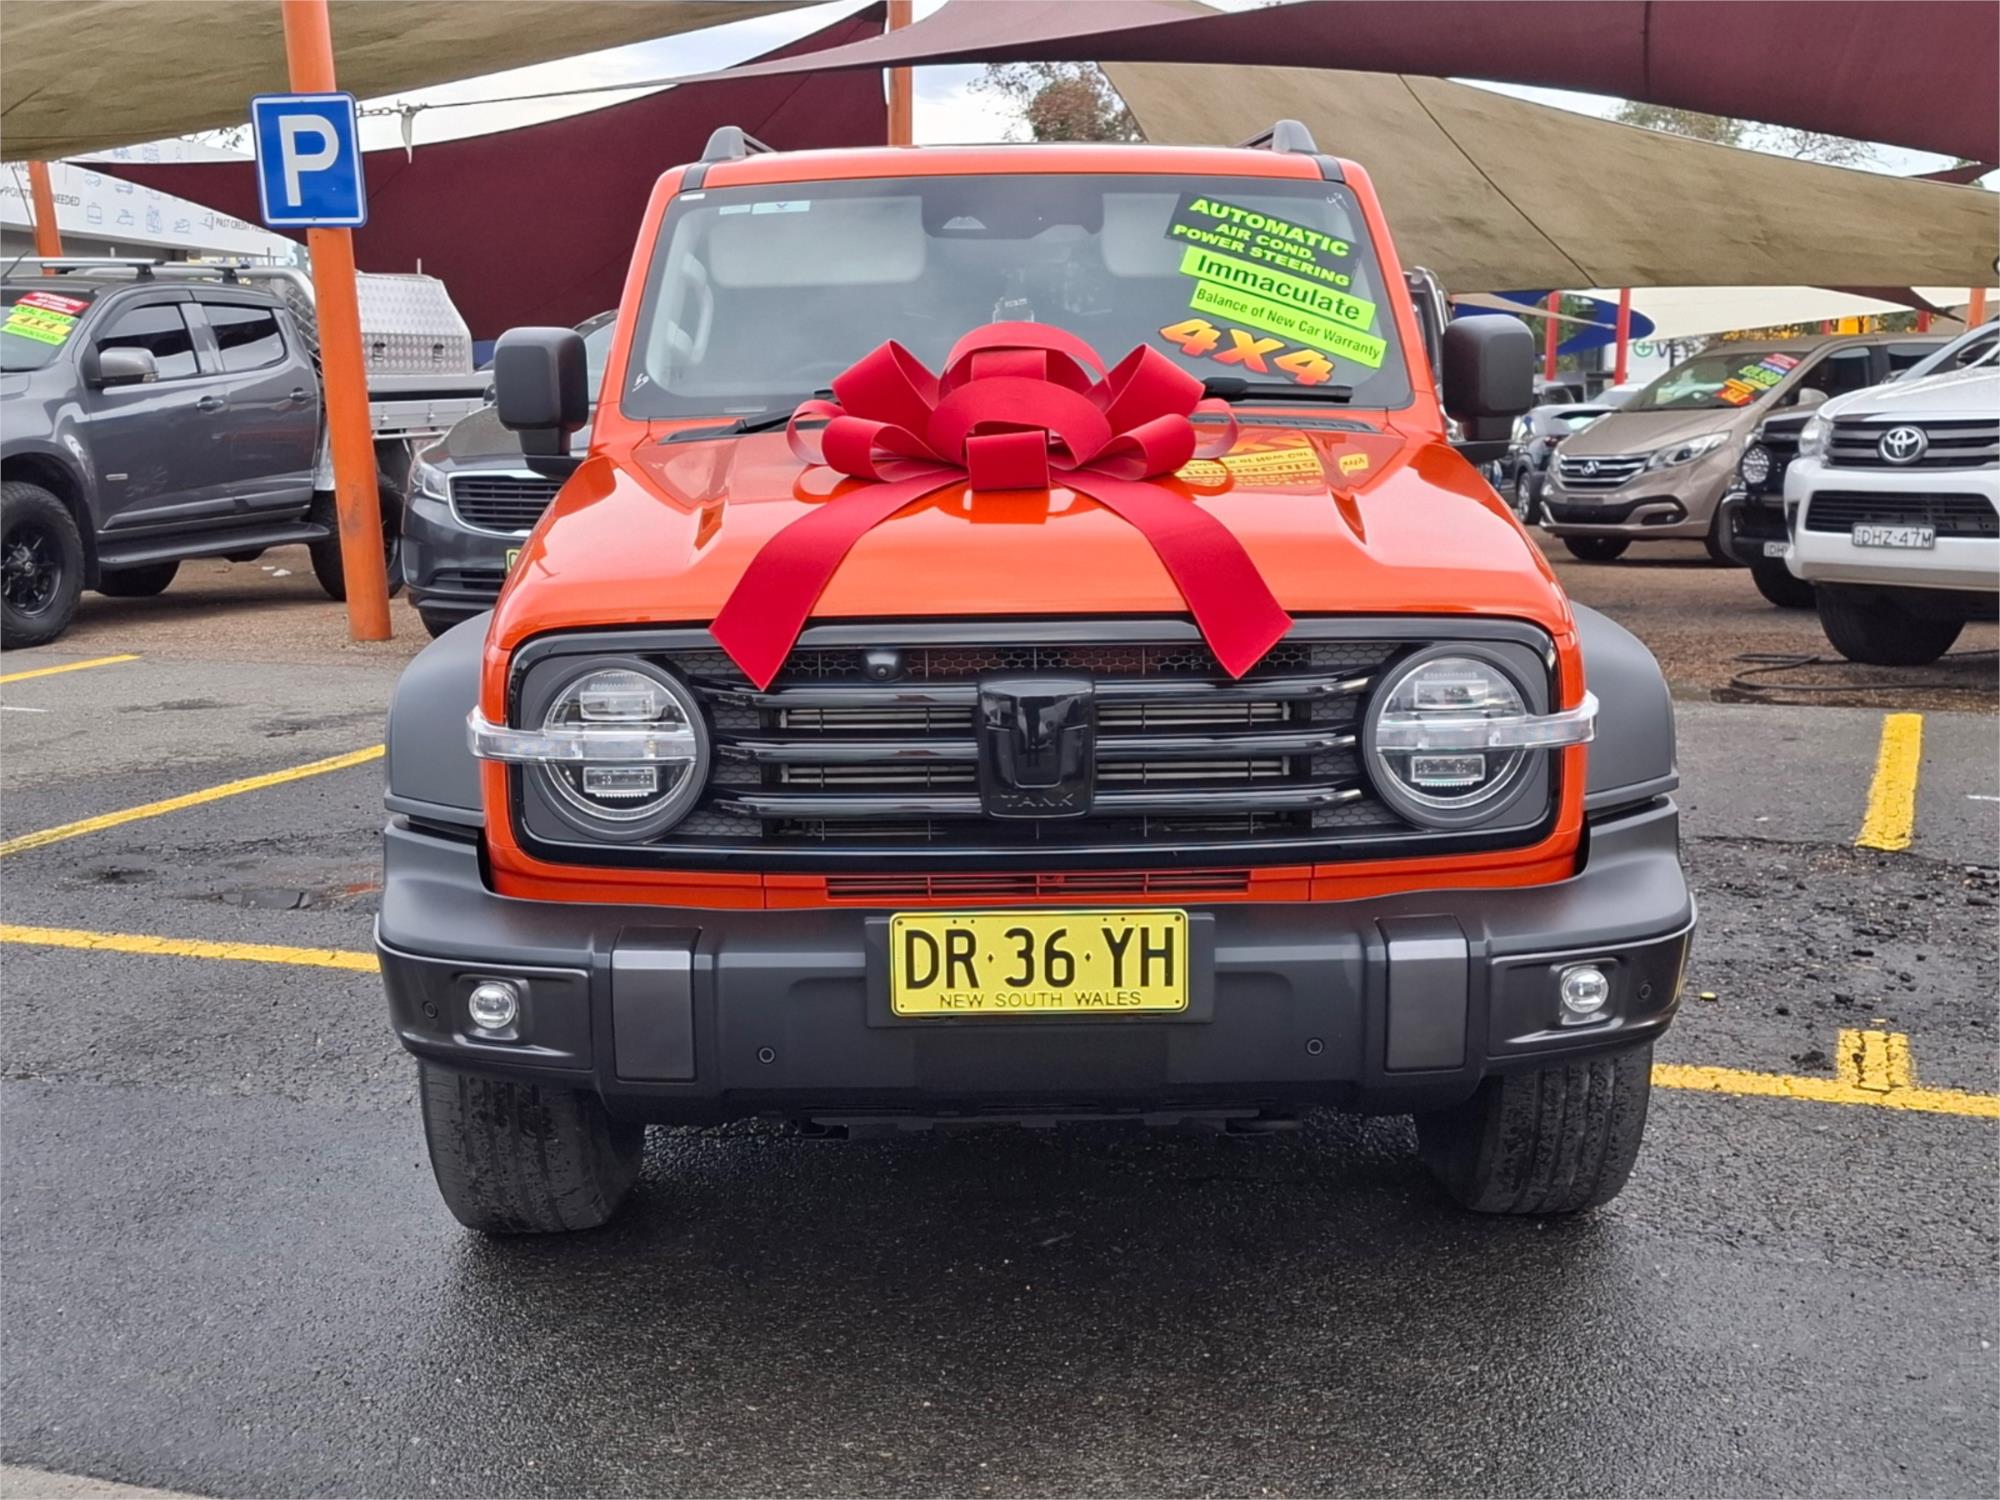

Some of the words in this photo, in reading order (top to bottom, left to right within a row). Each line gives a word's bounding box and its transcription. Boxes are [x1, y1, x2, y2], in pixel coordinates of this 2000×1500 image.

[279, 114, 339, 207] P
[1173, 224, 1245, 253] POWER
[1249, 247, 1350, 287] STEERING
[1189, 198, 1350, 256] AUTOMATIC
[1215, 223, 1251, 241] AIR
[1255, 234, 1316, 262] COND.
[1198, 255, 1360, 321] Immaculate
[1159, 318, 1335, 385] 4X4
[1196, 288, 1248, 313] Balance
[1251, 304, 1266, 318] of
[1267, 310, 1296, 329] New
[1298, 320, 1319, 337] Car
[1323, 328, 1381, 360] Warranty
[1000, 792, 1074, 808] TANK
[939, 993, 985, 1009] NEW
[995, 992, 1063, 1008] SOUTH
[1075, 991, 1142, 1007] WALES
